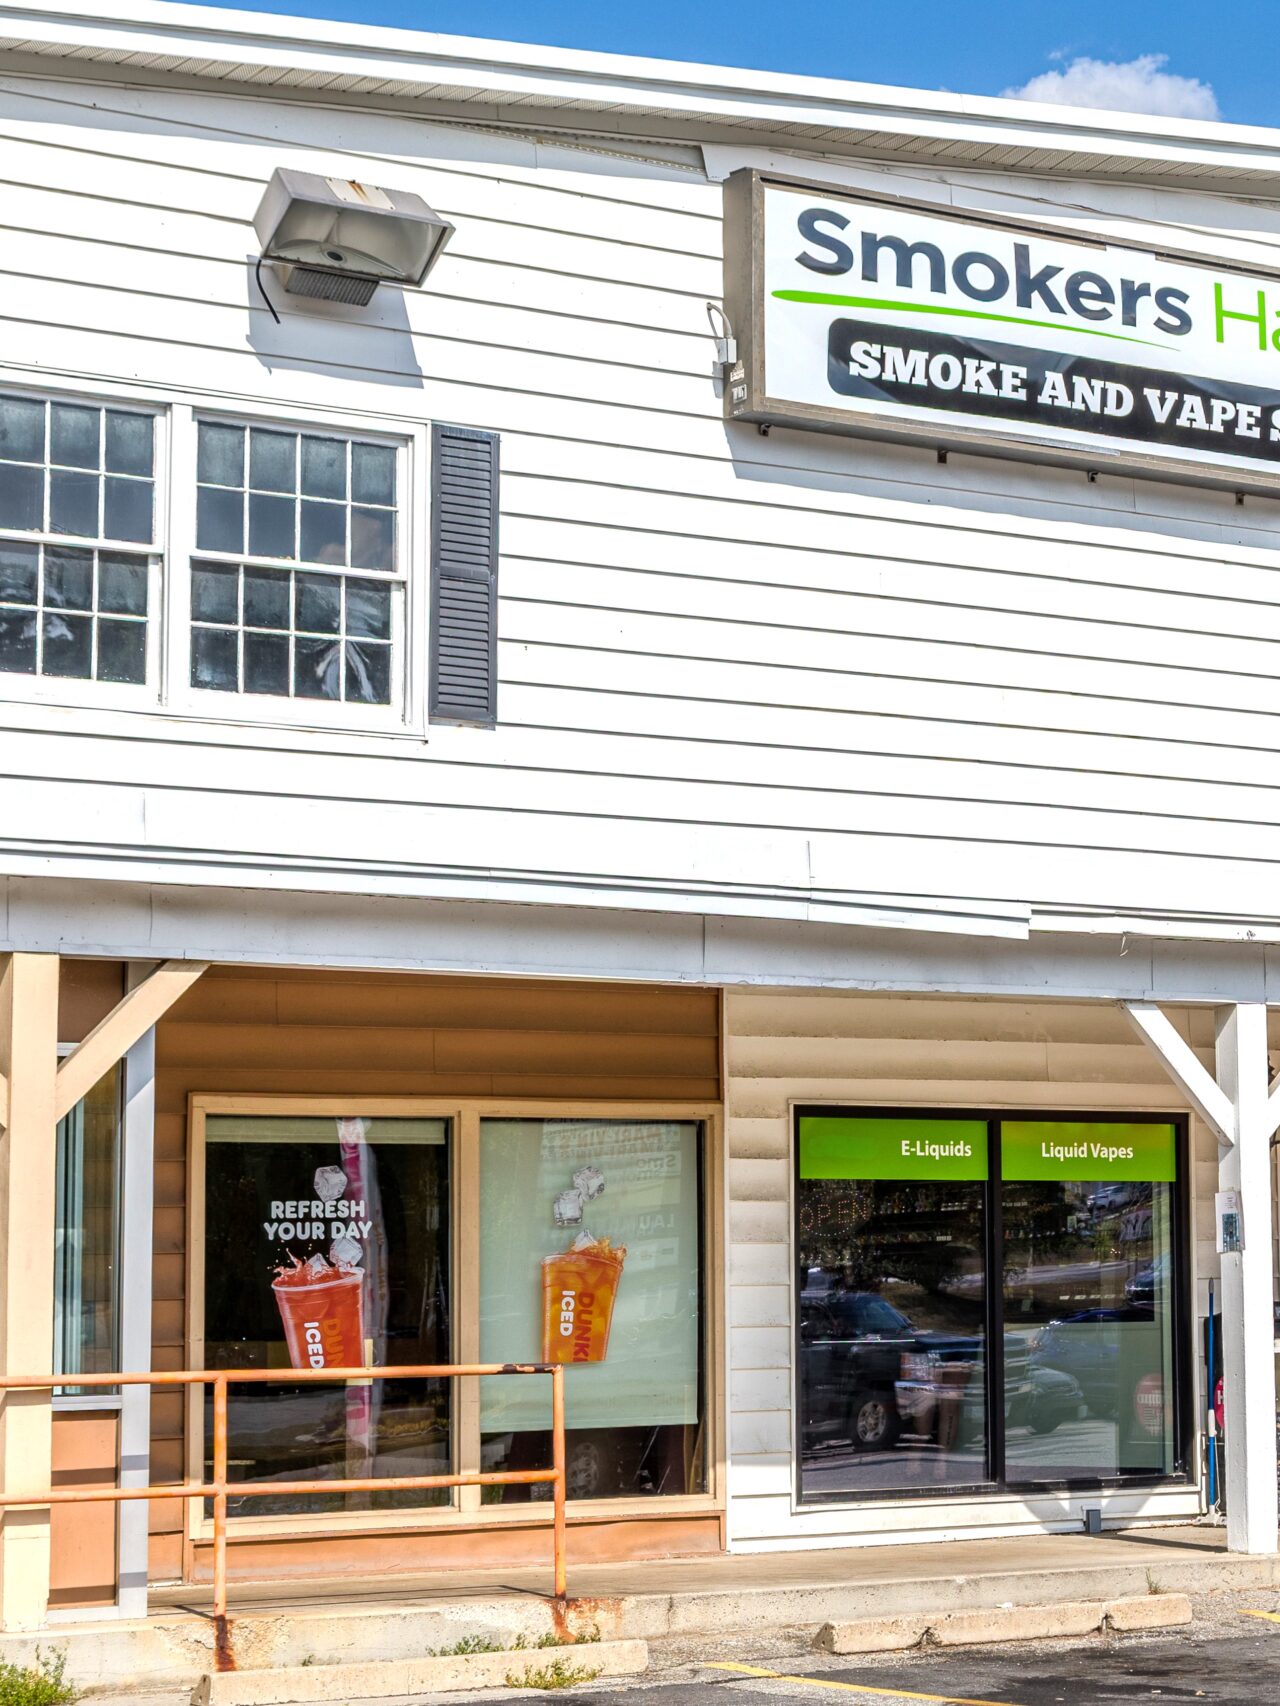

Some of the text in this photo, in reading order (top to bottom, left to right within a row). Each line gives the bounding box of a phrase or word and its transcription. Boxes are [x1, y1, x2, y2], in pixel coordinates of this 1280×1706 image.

[794, 207, 1193, 336] Smokers
[849, 340, 1027, 401] SMOKE
[1037, 370, 1134, 418] AND
[1143, 388, 1261, 440] VAPE
[901, 1140, 972, 1160] E-Liquids
[1041, 1142, 1134, 1162] Liquid Vapes
[271, 1200, 365, 1219] REFRESH
[800, 1199, 867, 1228] OPEN
[263, 1221, 373, 1240] YOUR DAY
[560, 1290, 576, 1337] ICED
[304, 1322, 324, 1369] ICED
